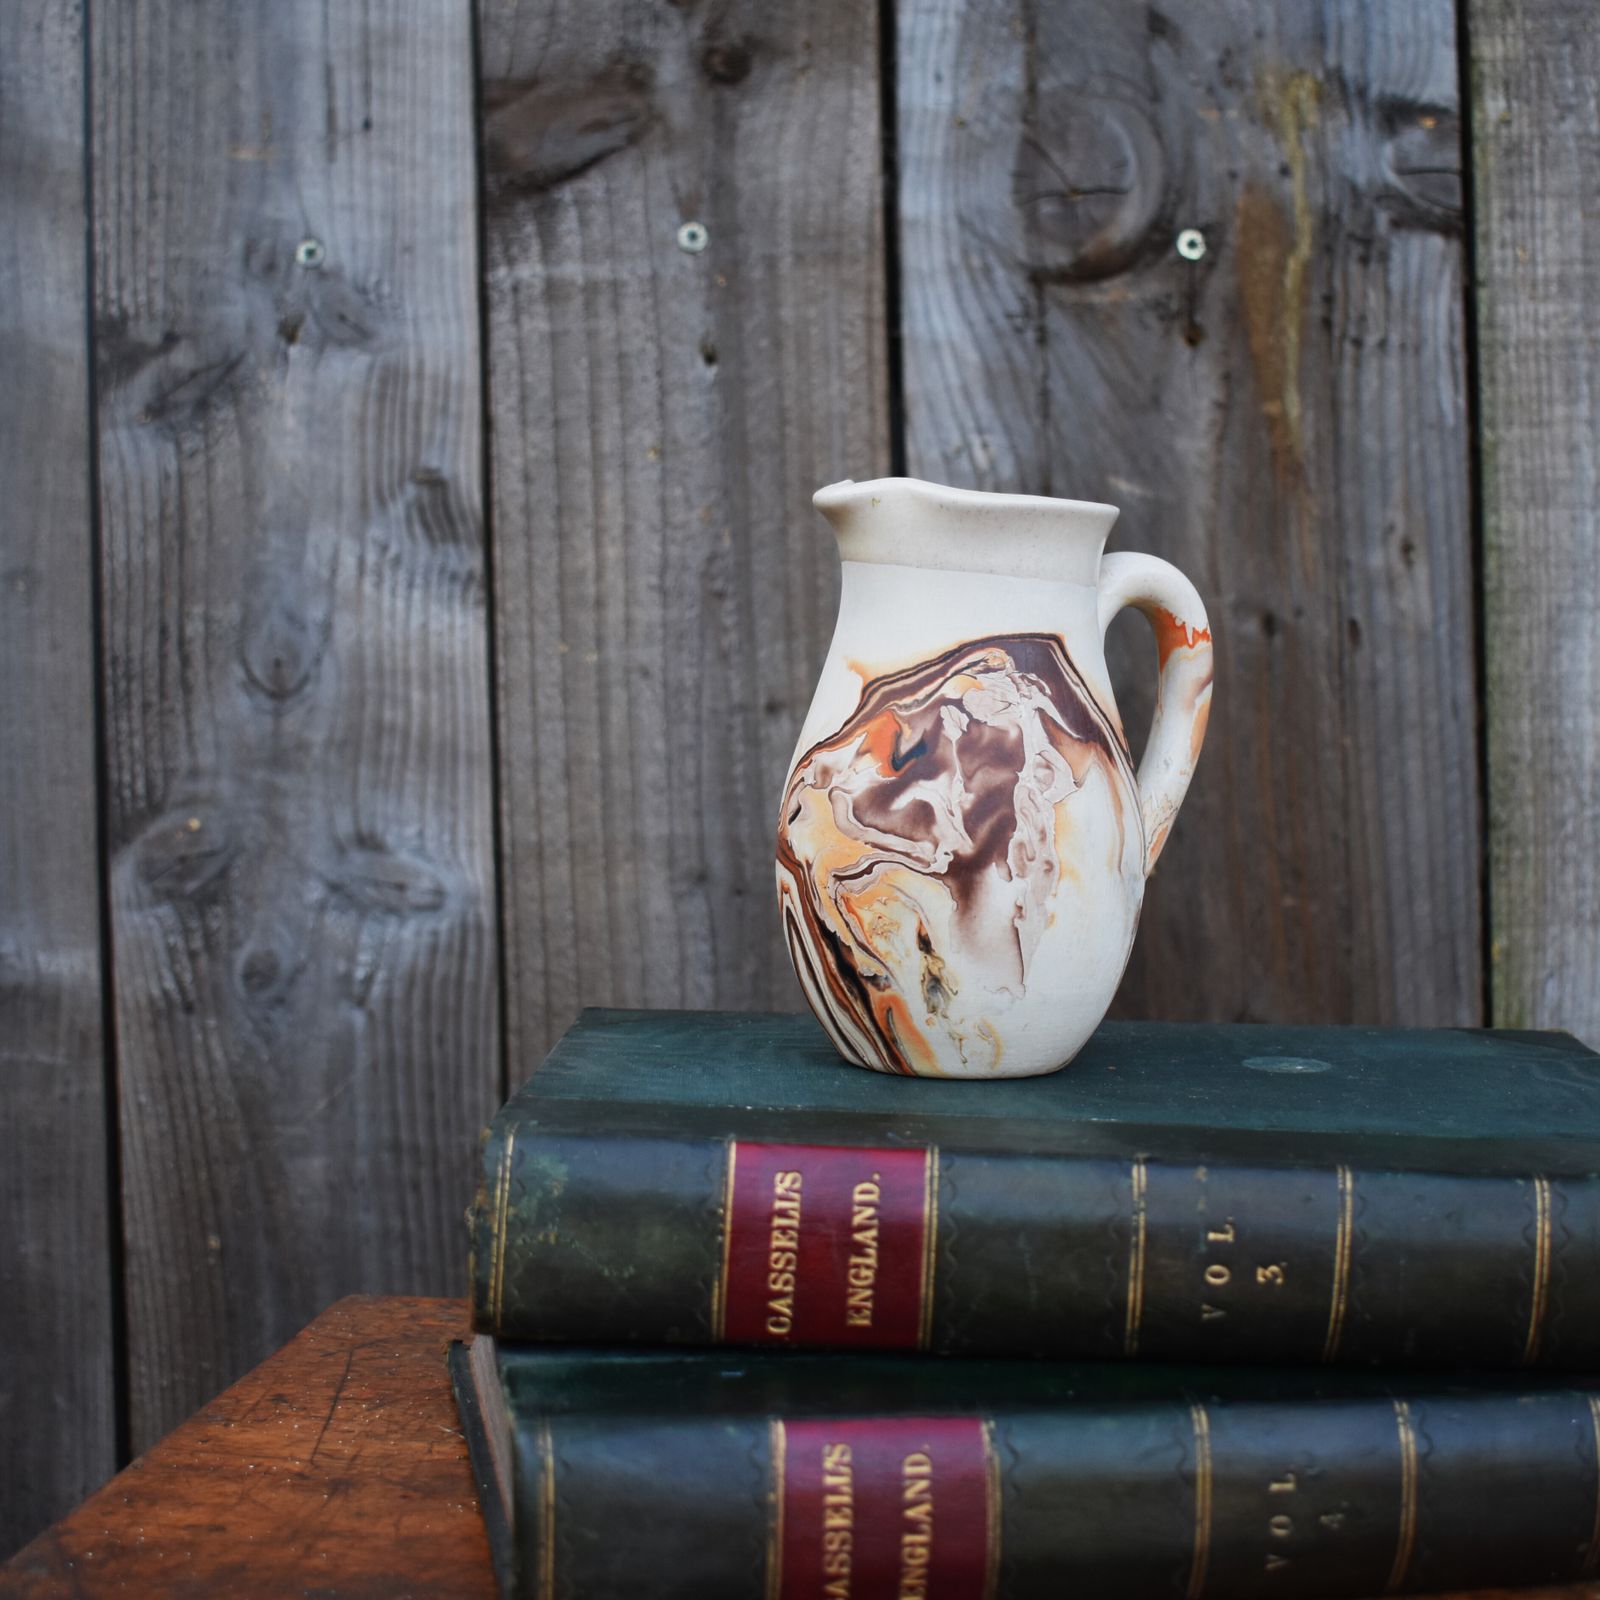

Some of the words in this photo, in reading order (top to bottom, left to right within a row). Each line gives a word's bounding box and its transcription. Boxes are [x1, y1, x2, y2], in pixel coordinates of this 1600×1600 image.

[766, 1170, 803, 1336] CASSELL'S
[846, 1172, 881, 1327] ENGLAND.
[823, 1443, 854, 1600] ASSELL'S
